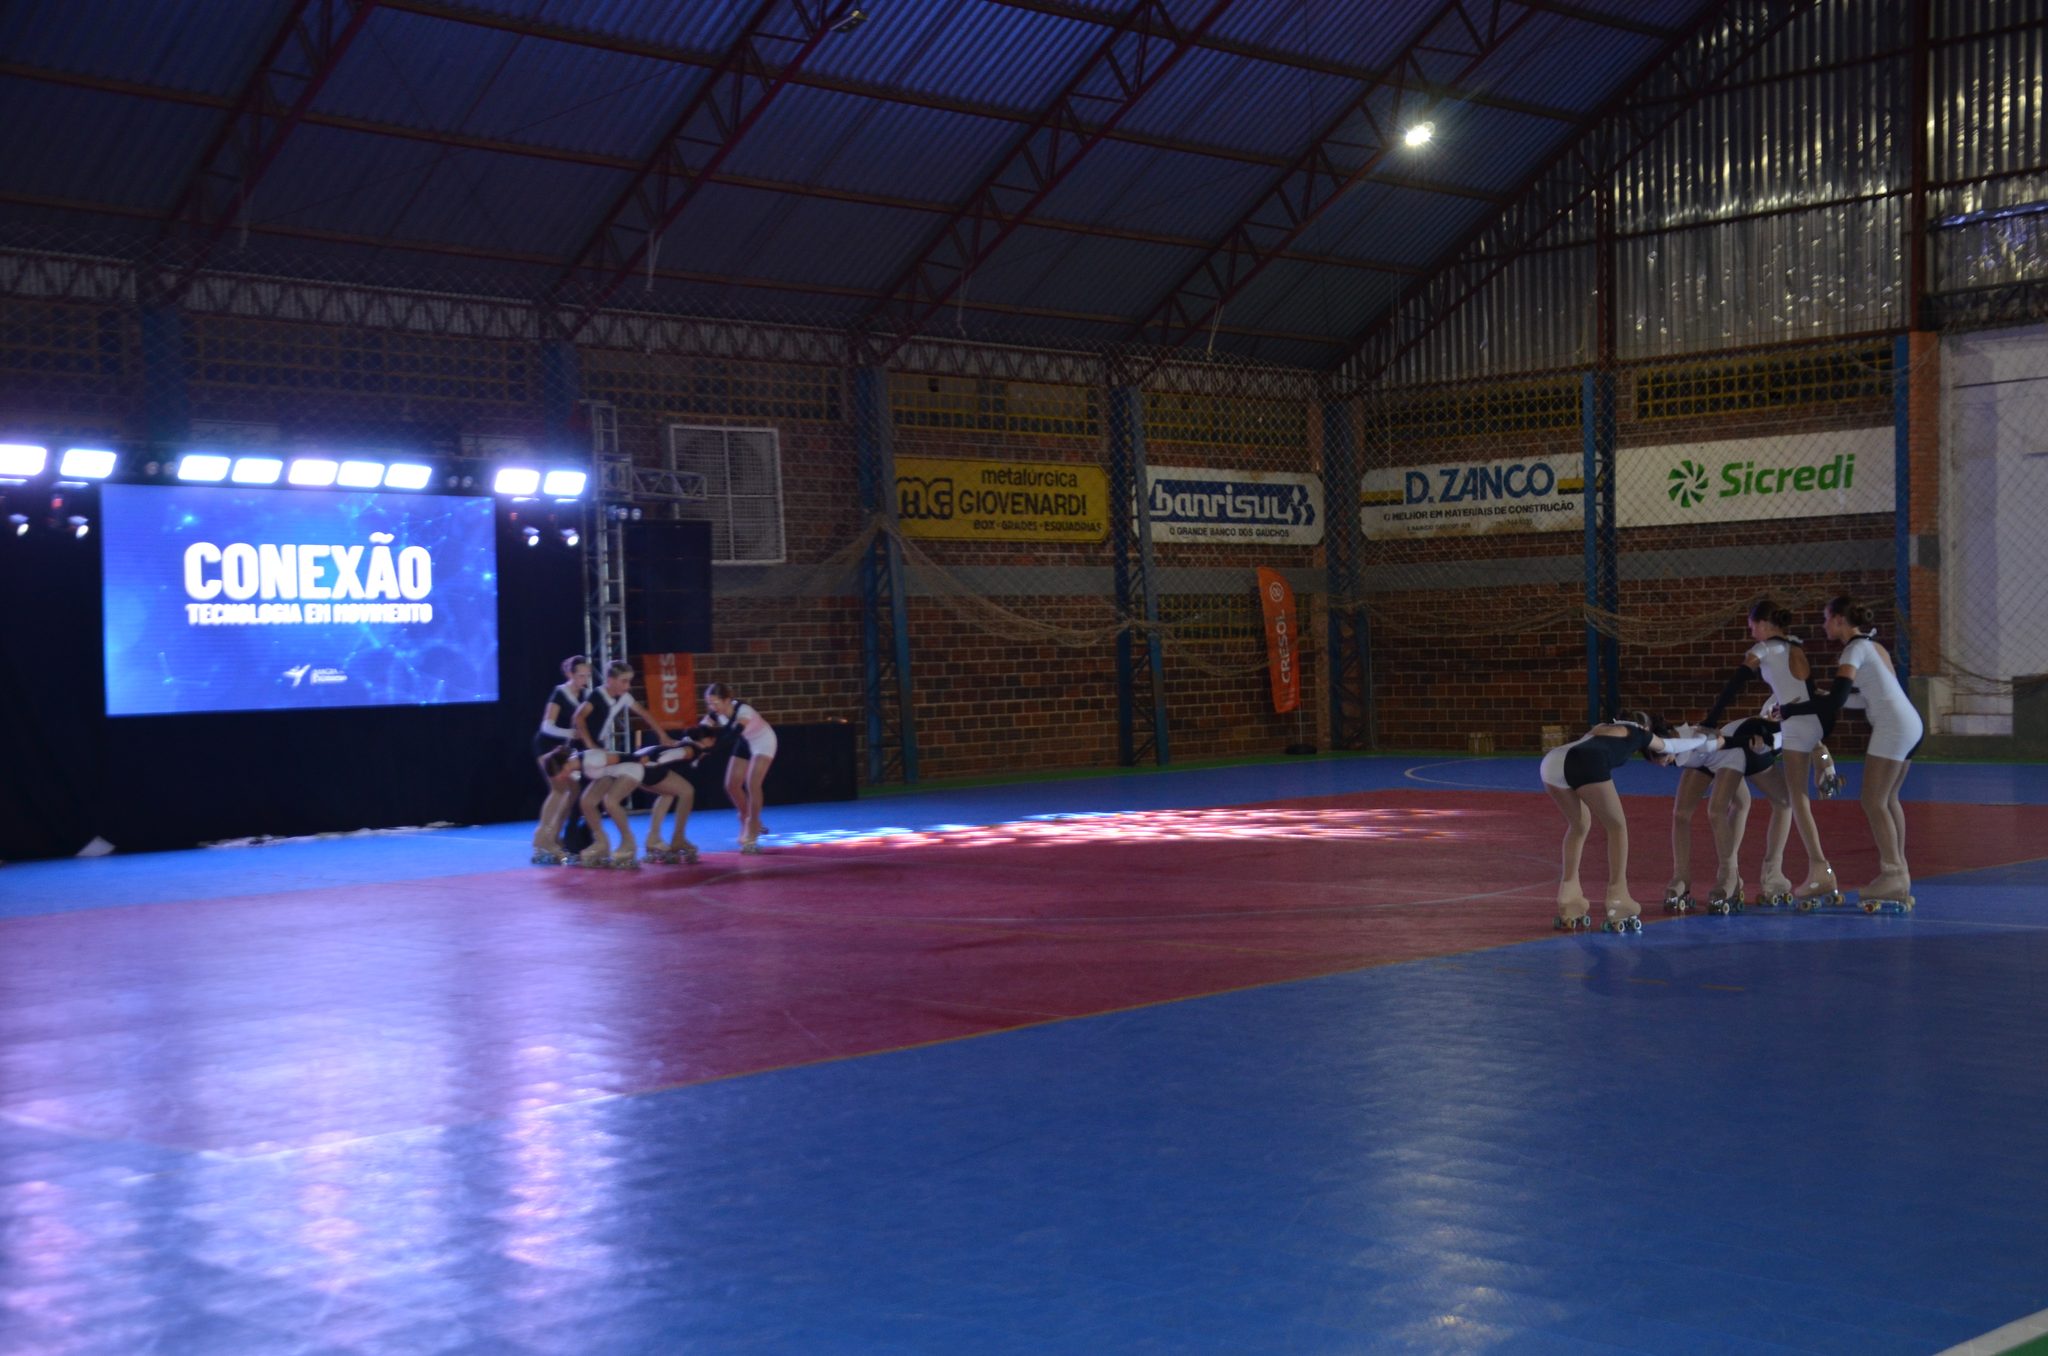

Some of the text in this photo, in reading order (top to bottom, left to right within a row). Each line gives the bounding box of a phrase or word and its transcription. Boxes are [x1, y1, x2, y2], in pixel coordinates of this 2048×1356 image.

[1719, 453, 1857, 498] Sicredi
[959, 489, 1087, 516] GIOVENARDI
[1149, 484, 1292, 520] banrisul
[1392, 511, 1428, 521] MELHOR
[1430, 510, 1443, 519] EM
[1445, 508, 1493, 518] MATERIAIS
[1494, 507, 1507, 516] DE
[1508, 502, 1575, 514] CONSTRUÇÃO
[1169, 527, 1175, 536] O
[1177, 527, 1208, 536] GRANDE
[1209, 528, 1235, 537] BANCO
[1239, 528, 1253, 537] DOS
[184, 531, 433, 601] CONEXÃO
[186, 603, 433, 625] TECNOLOGIA EM MOVIMENTO
[1275, 608, 1291, 684] CRESOL
